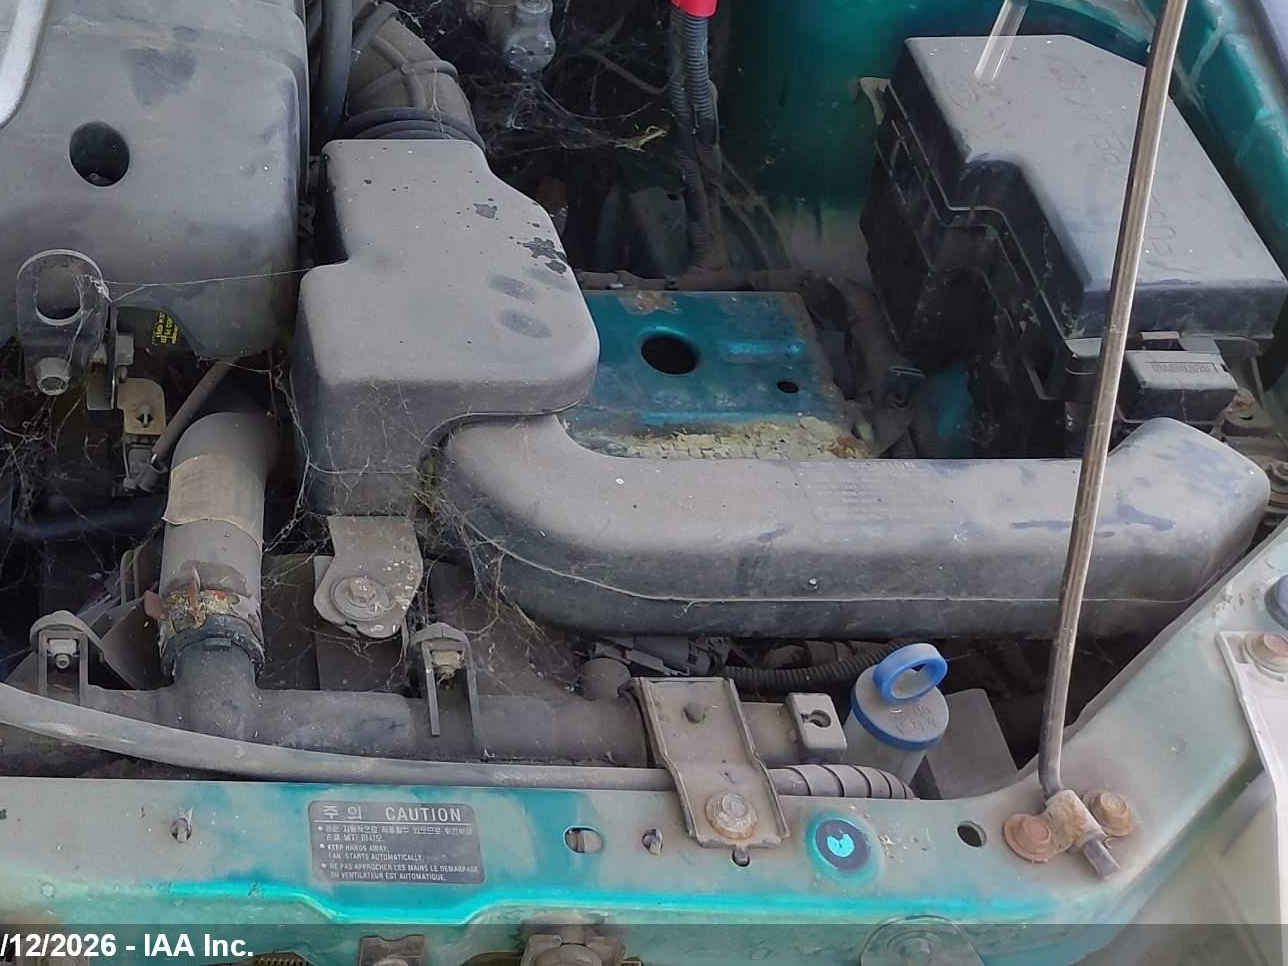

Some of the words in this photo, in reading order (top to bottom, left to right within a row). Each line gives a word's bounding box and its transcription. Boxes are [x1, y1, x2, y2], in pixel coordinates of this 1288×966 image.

[385, 807, 461, 822] CAUTION
[327, 843, 344, 851] KEEP
[346, 844, 368, 852] HANDS
[345, 852, 370, 860] STARTS
[407, 864, 429, 872] MAINS
[341, 871, 384, 880] VENTILATEUR
[385, 872, 397, 880] EST
